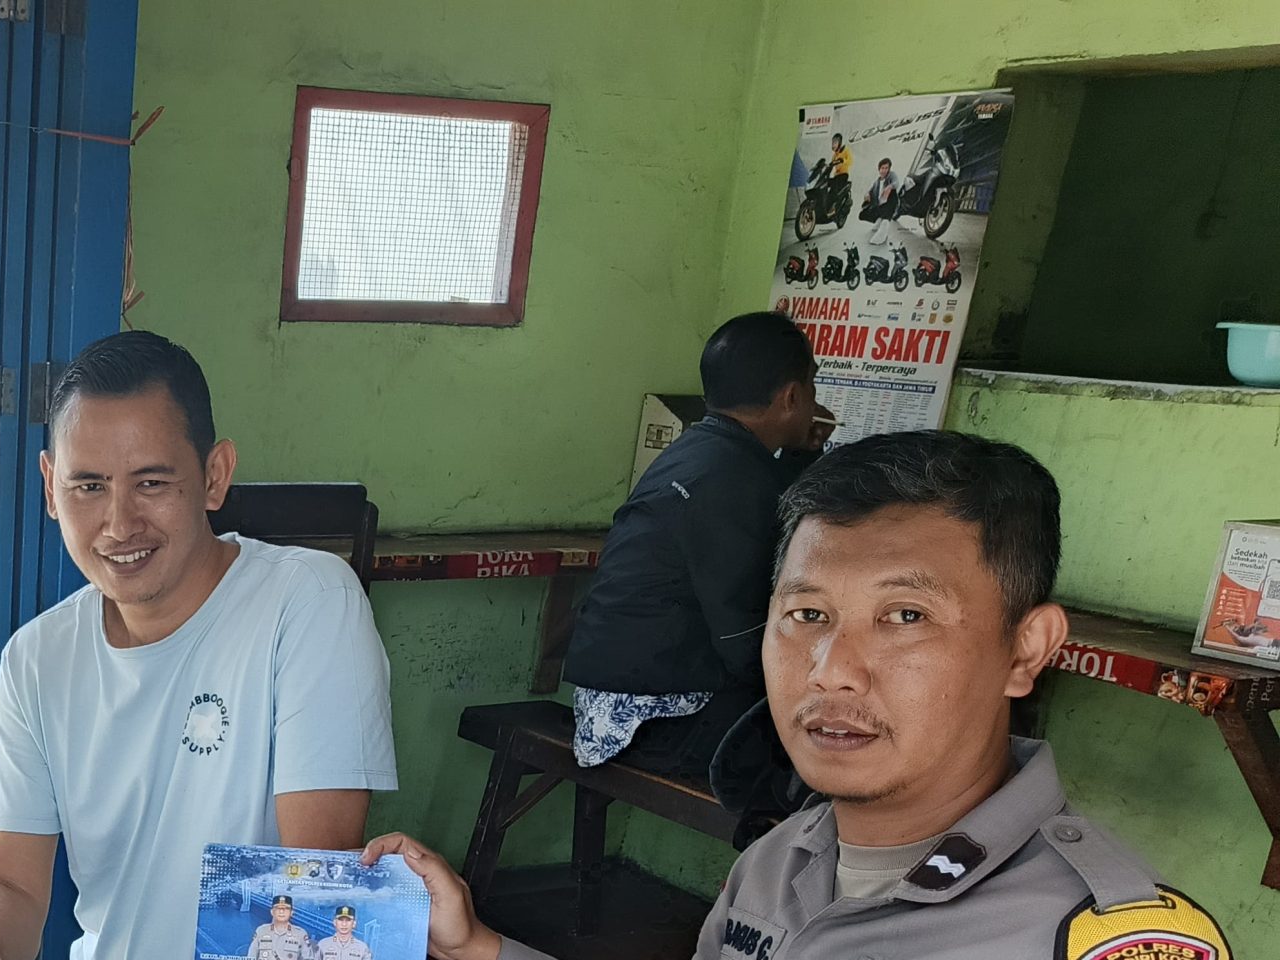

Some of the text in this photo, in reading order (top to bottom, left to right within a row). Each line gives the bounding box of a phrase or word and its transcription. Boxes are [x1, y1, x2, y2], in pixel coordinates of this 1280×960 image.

[790, 297, 850, 321] YAMAHA
[796, 322, 951, 364] TARAM SAKTI
[819, 358, 853, 370] Terbaik
[861, 362, 917, 377] Terpercaya
[1234, 548, 1268, 560] Sedekah
[182, 734, 225, 756] SUPPLY
